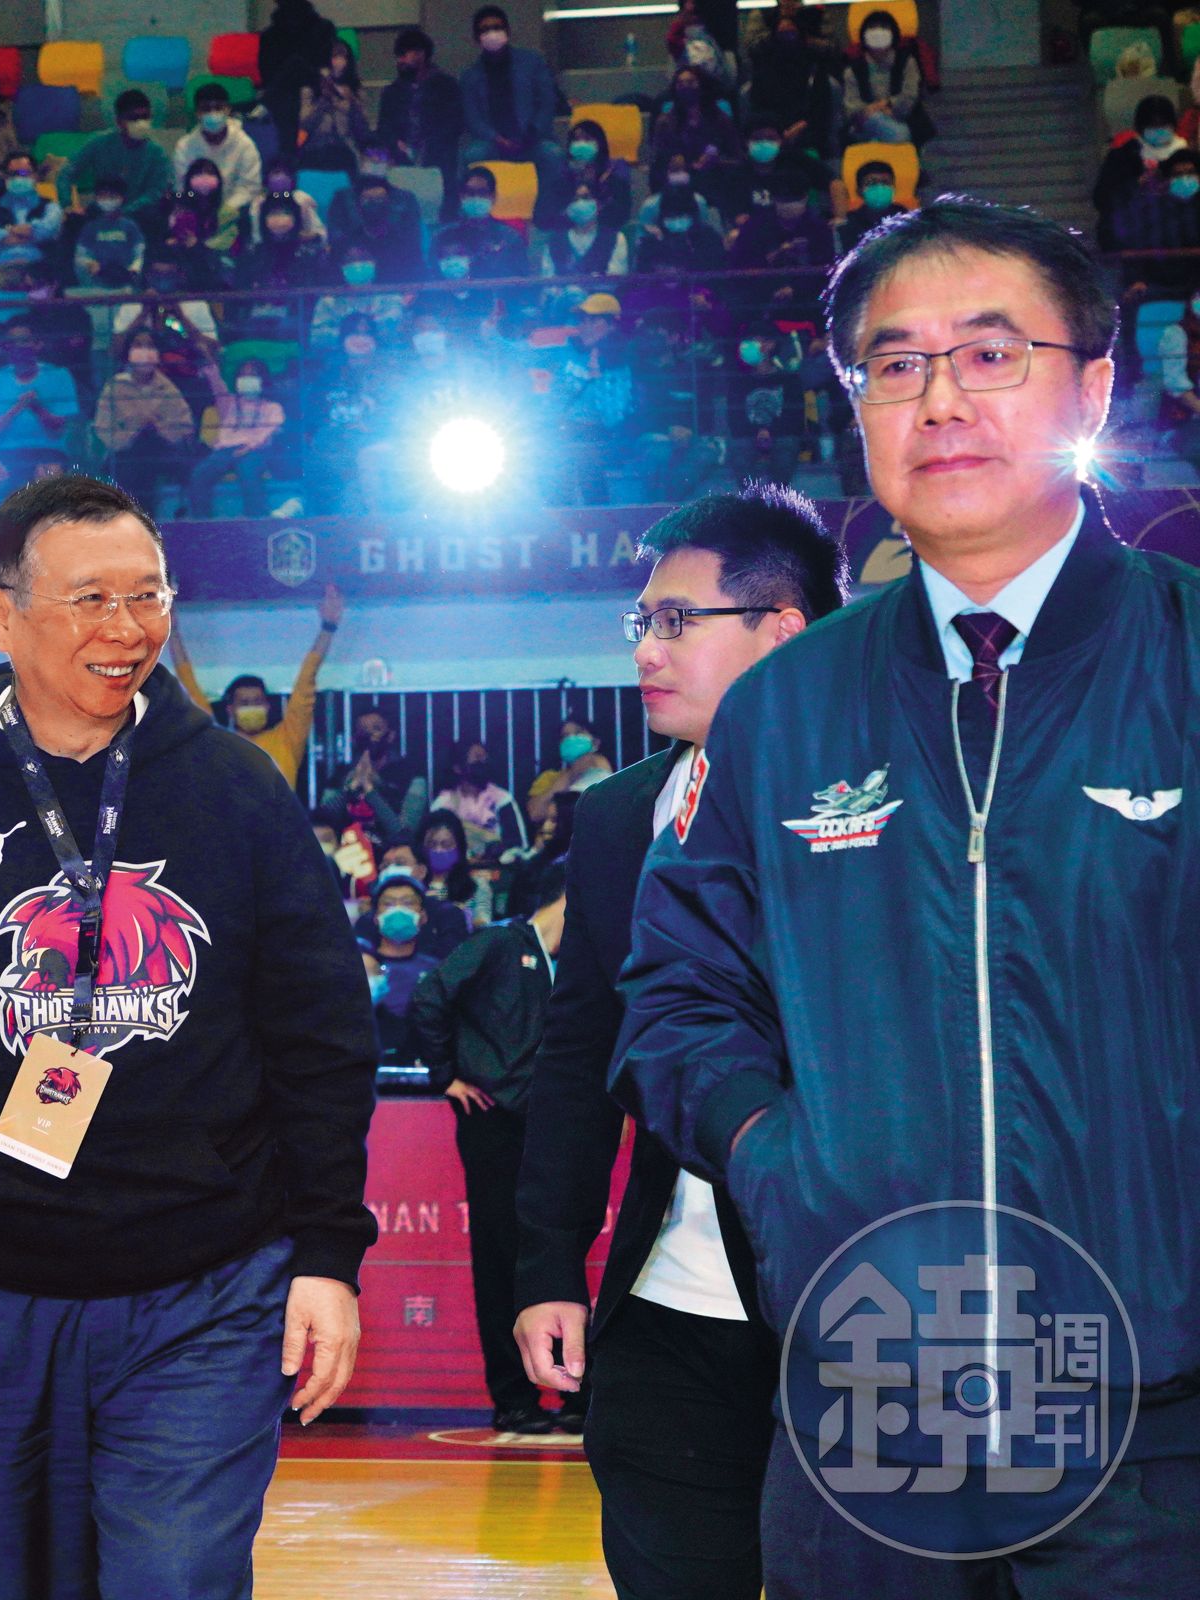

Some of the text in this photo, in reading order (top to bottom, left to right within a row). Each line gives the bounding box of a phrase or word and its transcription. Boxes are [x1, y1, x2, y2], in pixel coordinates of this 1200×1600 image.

[358, 533, 540, 574] GHOST
[102, 806, 115, 835] HAWKS
[8, 988, 178, 1036] GHOS HAWKS
[37, 1117, 52, 1129] VIP
[371, 1201, 441, 1233] NAN
[404, 1296, 435, 1327] 南
